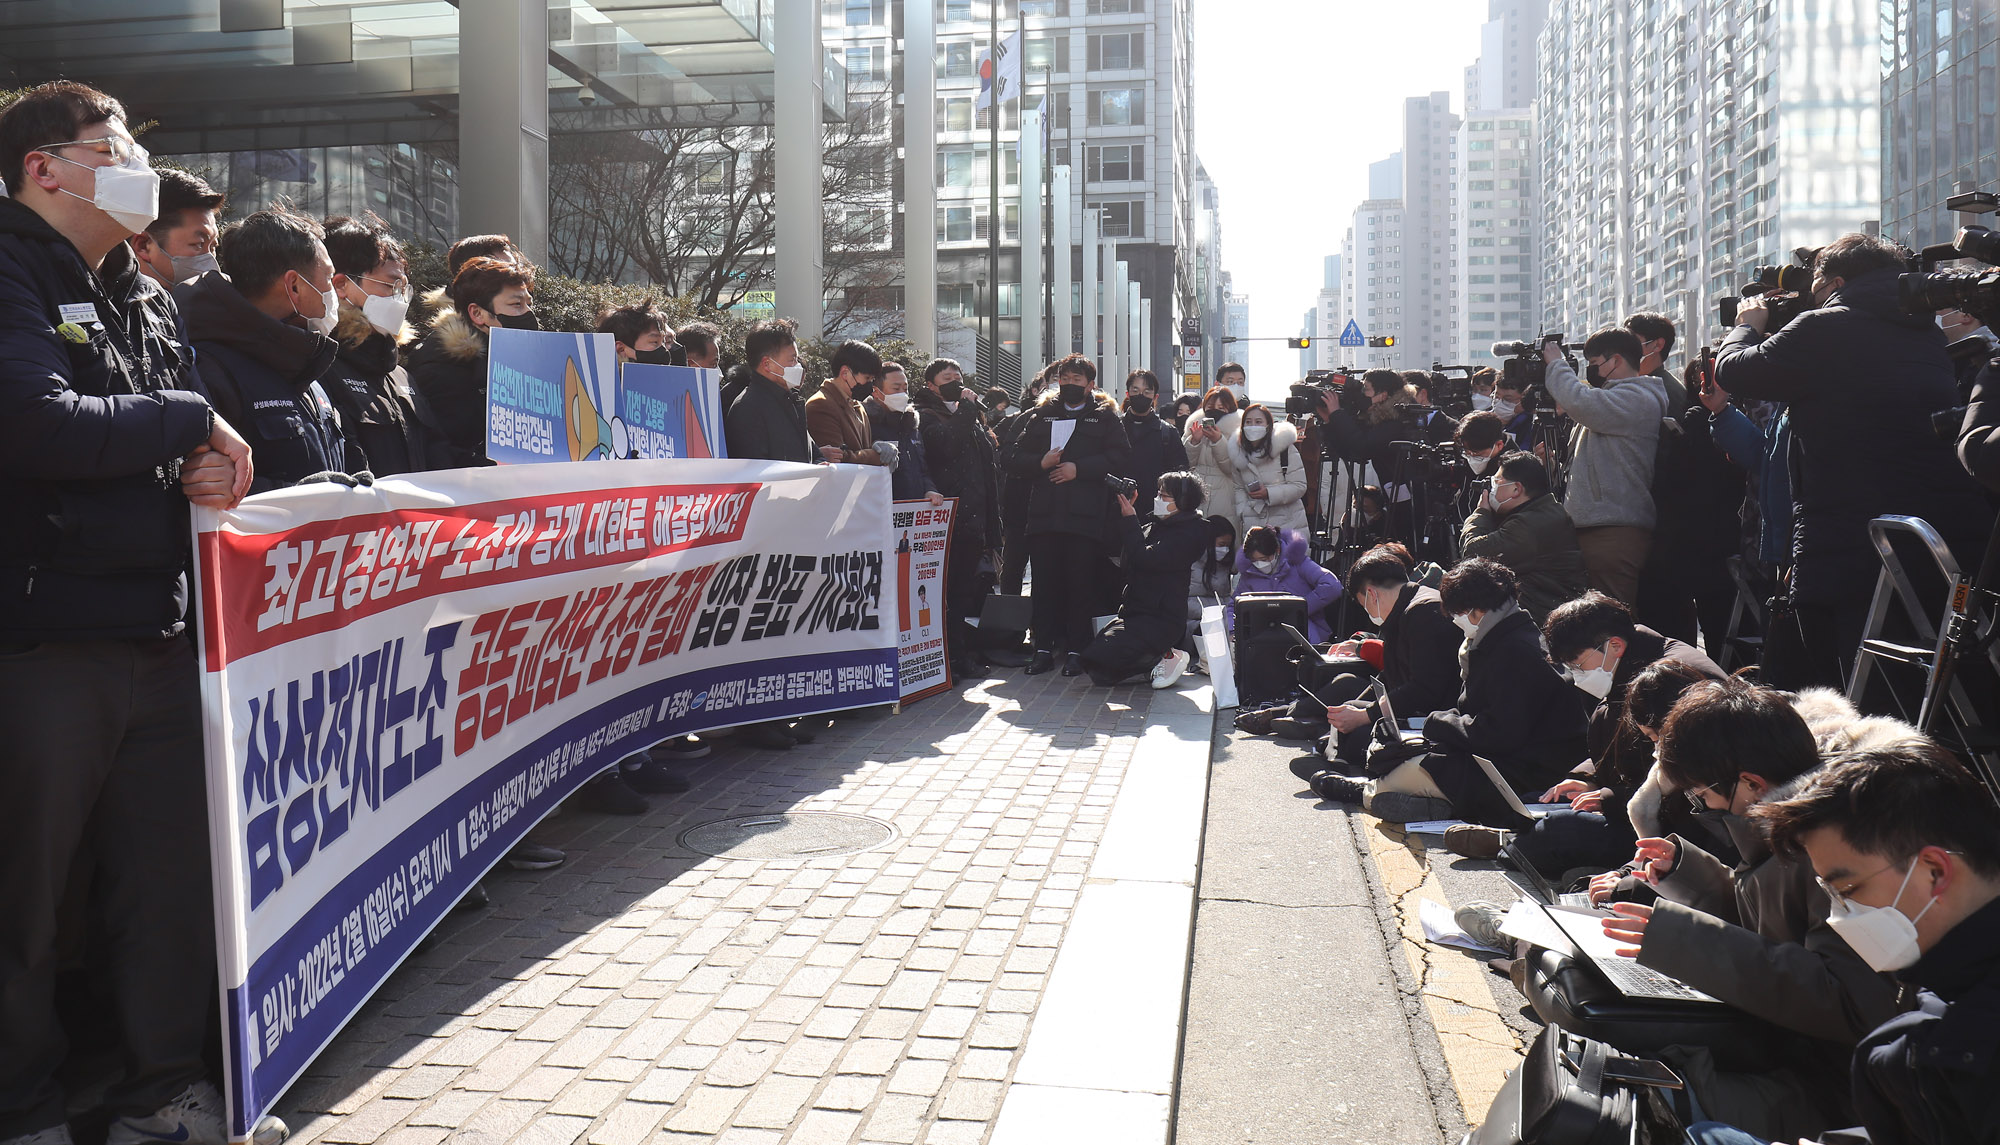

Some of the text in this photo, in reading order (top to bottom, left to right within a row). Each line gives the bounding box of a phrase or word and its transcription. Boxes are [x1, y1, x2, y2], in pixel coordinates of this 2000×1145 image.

[1187, 319, 1199, 333] 약
[492, 361, 562, 418] 삼성전자 대표이사
[491, 403, 553, 455] 한종희 부회장님!
[915, 509, 932, 526] 임금
[933, 508, 950, 524] 격차
[257, 491, 749, 633] 최고경영진-노조와 공개 대화로 해결합시다!
[917, 567, 937, 580] 200만원
[454, 582, 624, 757] 공동교섭단
[689, 553, 760, 651] 입장
[741, 553, 816, 642] 발표
[793, 550, 883, 635] 기자회견
[263, 973, 297, 1059] 일시:
[298, 925, 345, 1019] 2022년
[342, 902, 367, 972] 2월
[363, 864, 409, 950] 16일(수)
[409, 848, 433, 906] 오전
[432, 829, 452, 885] 11시
[468, 800, 490, 852] 장소:
[492, 770, 526, 833] 삼성전자
[527, 746, 560, 803] 서초사옥
[559, 741, 571, 779] 앞
[570, 736, 587, 771] (서울
[584, 725, 606, 758] 서초구
[668, 689, 692, 721] 주최:
[705, 679, 746, 712] 삼성전자
[746, 672, 785, 706] 노동조합
[786, 668, 834, 700] 공동교섭단,
[837, 663, 873, 692] 법무법인
[875, 663, 894, 687] 여는
